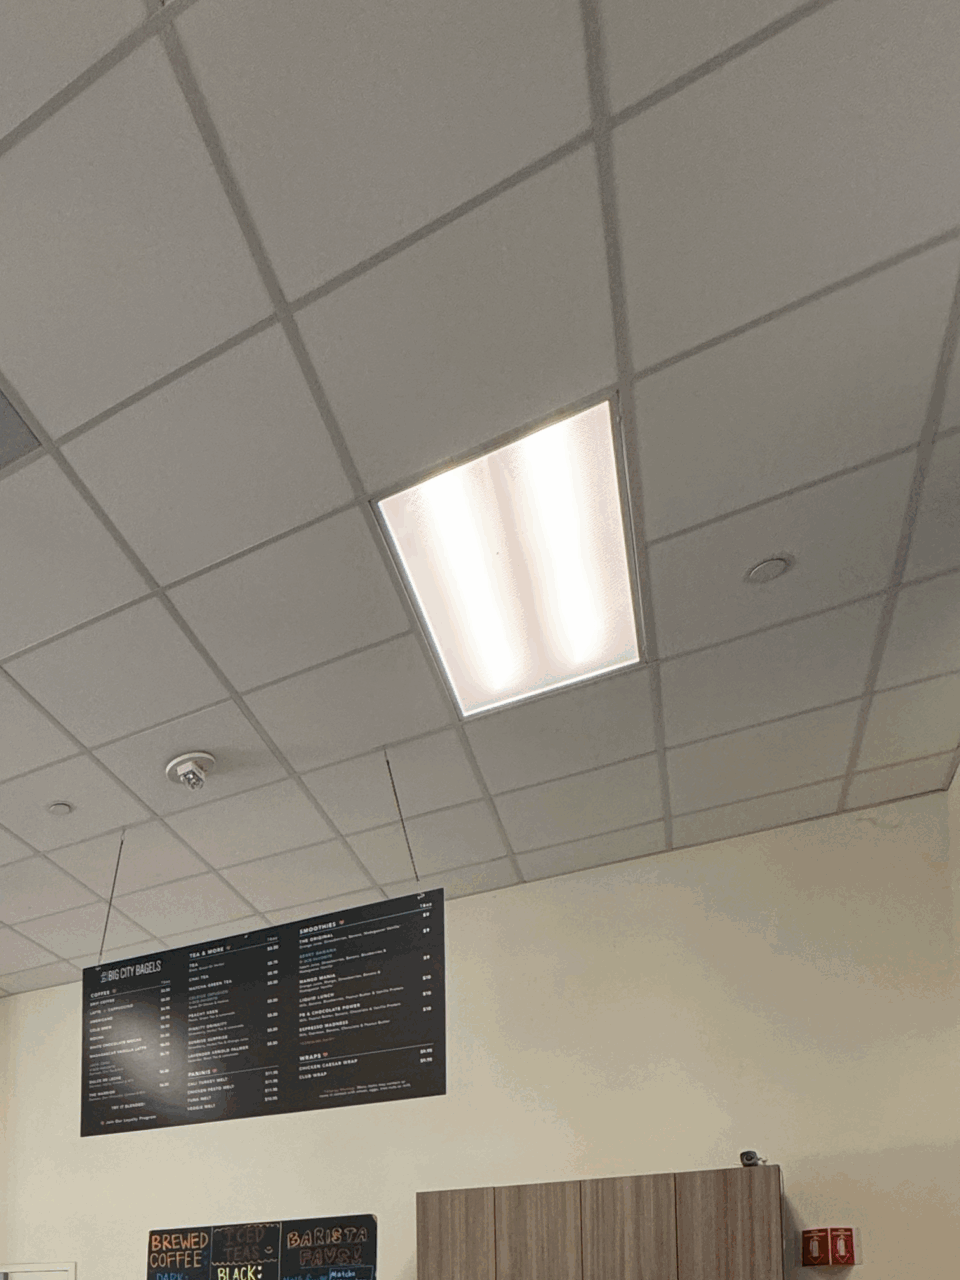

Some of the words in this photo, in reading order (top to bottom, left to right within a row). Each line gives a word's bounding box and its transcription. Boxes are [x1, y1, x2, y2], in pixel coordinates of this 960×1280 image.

[299, 922, 336, 934] SMOOTHIES
[310, 933, 333, 942] ORIGINAL
[109, 969, 119, 981] BIG
[120, 967, 135, 979] CITY
[136, 960, 162, 976] BAGELS
[319, 973, 336, 981] MANIA
[90, 990, 110, 998] COFFEE
[299, 995, 316, 1003] LIQUID
[312, 1006, 341, 1015] CHOCOLATE
[90, 1016, 113, 1024] AMERICANO
[299, 1024, 323, 1032] ESPRESSO
[324, 1020, 348, 1028] MADNESS
[299, 1053, 321, 1061] WRAPS
[226, 1226, 265, 1243] ICED
[287, 1227, 368, 1250] BARISTA
[151, 1232, 209, 1252] BREWED
[149, 1250, 203, 1269] COFFEE
[224, 1246, 261, 1261] TEAS
[299, 1245, 362, 1267] FAVS!
